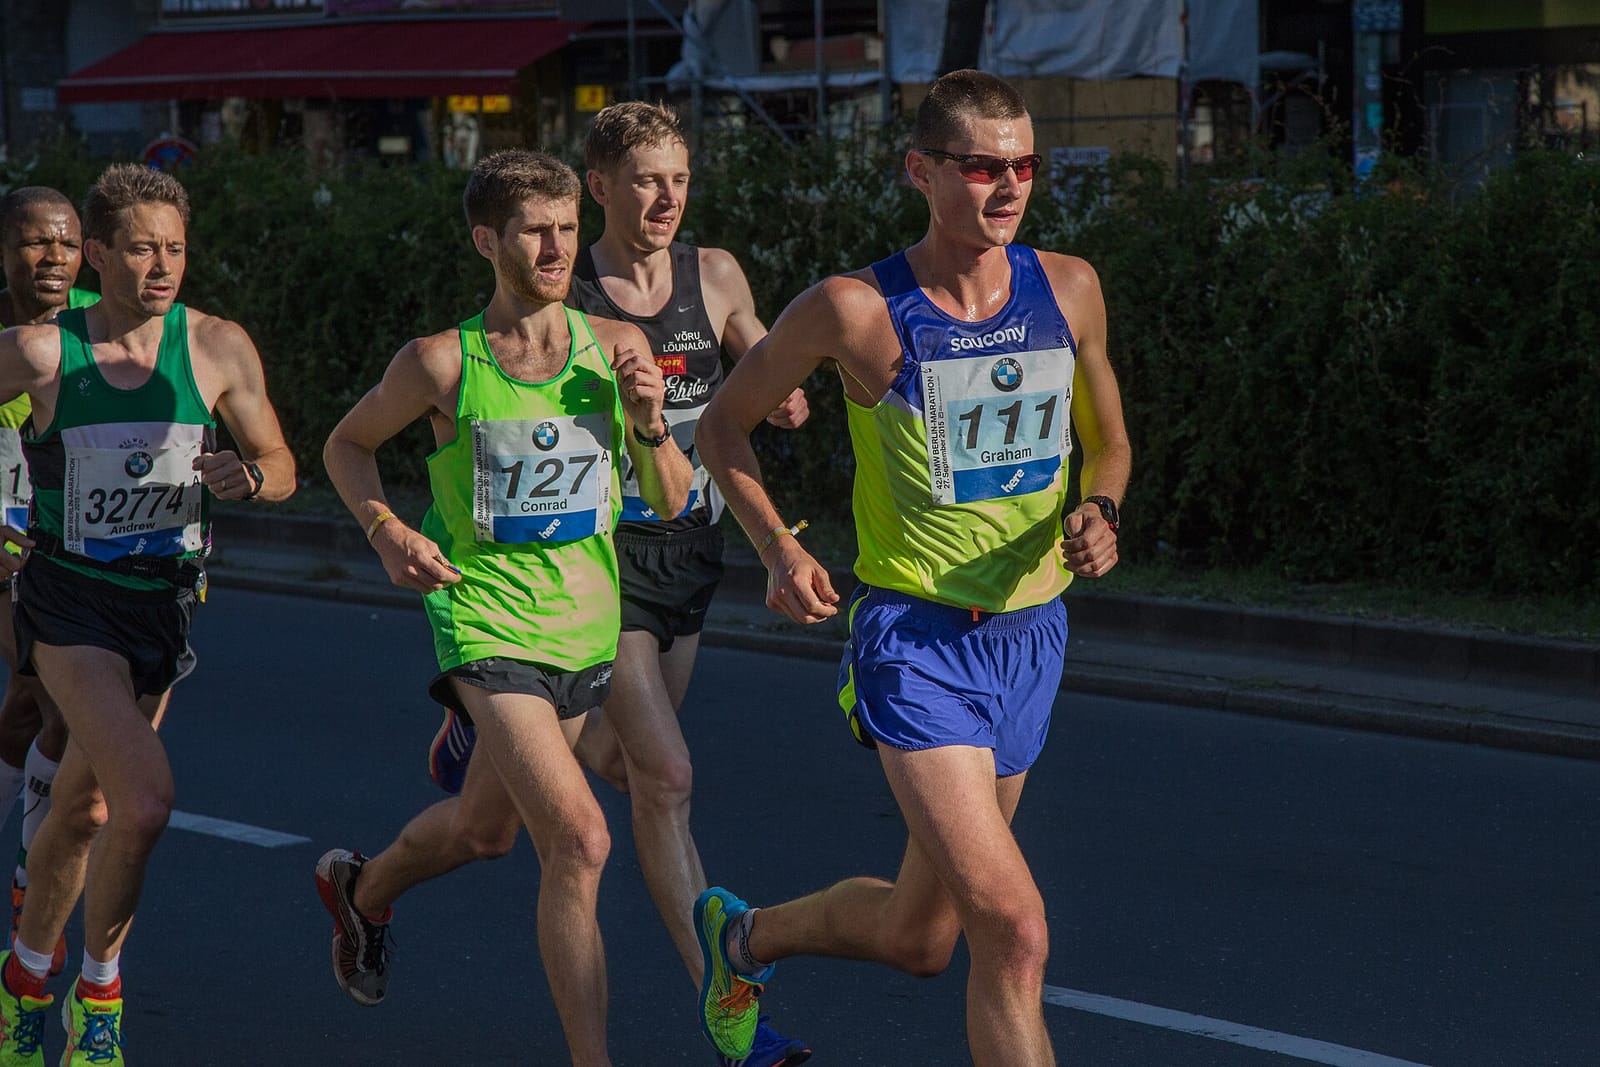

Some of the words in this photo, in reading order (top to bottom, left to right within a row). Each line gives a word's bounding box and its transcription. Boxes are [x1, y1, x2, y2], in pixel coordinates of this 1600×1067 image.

[674, 330, 700, 341] VÕRU
[951, 325, 1026, 351] saucony
[1064, 387, 1071, 402] A
[927, 376, 939, 456] BERLIN-MARATHON
[959, 394, 1057, 449] 111
[600, 451, 609, 463] A
[941, 440, 949, 478] September
[981, 446, 1032, 464] Graham
[501, 454, 598, 499] 127
[933, 456, 942, 477] BMW
[1000, 468, 1025, 493] here
[85, 481, 185, 525] 32774
[520, 499, 568, 513] Conrad
[110, 521, 156, 536] Andrew
[537, 518, 562, 540] here
